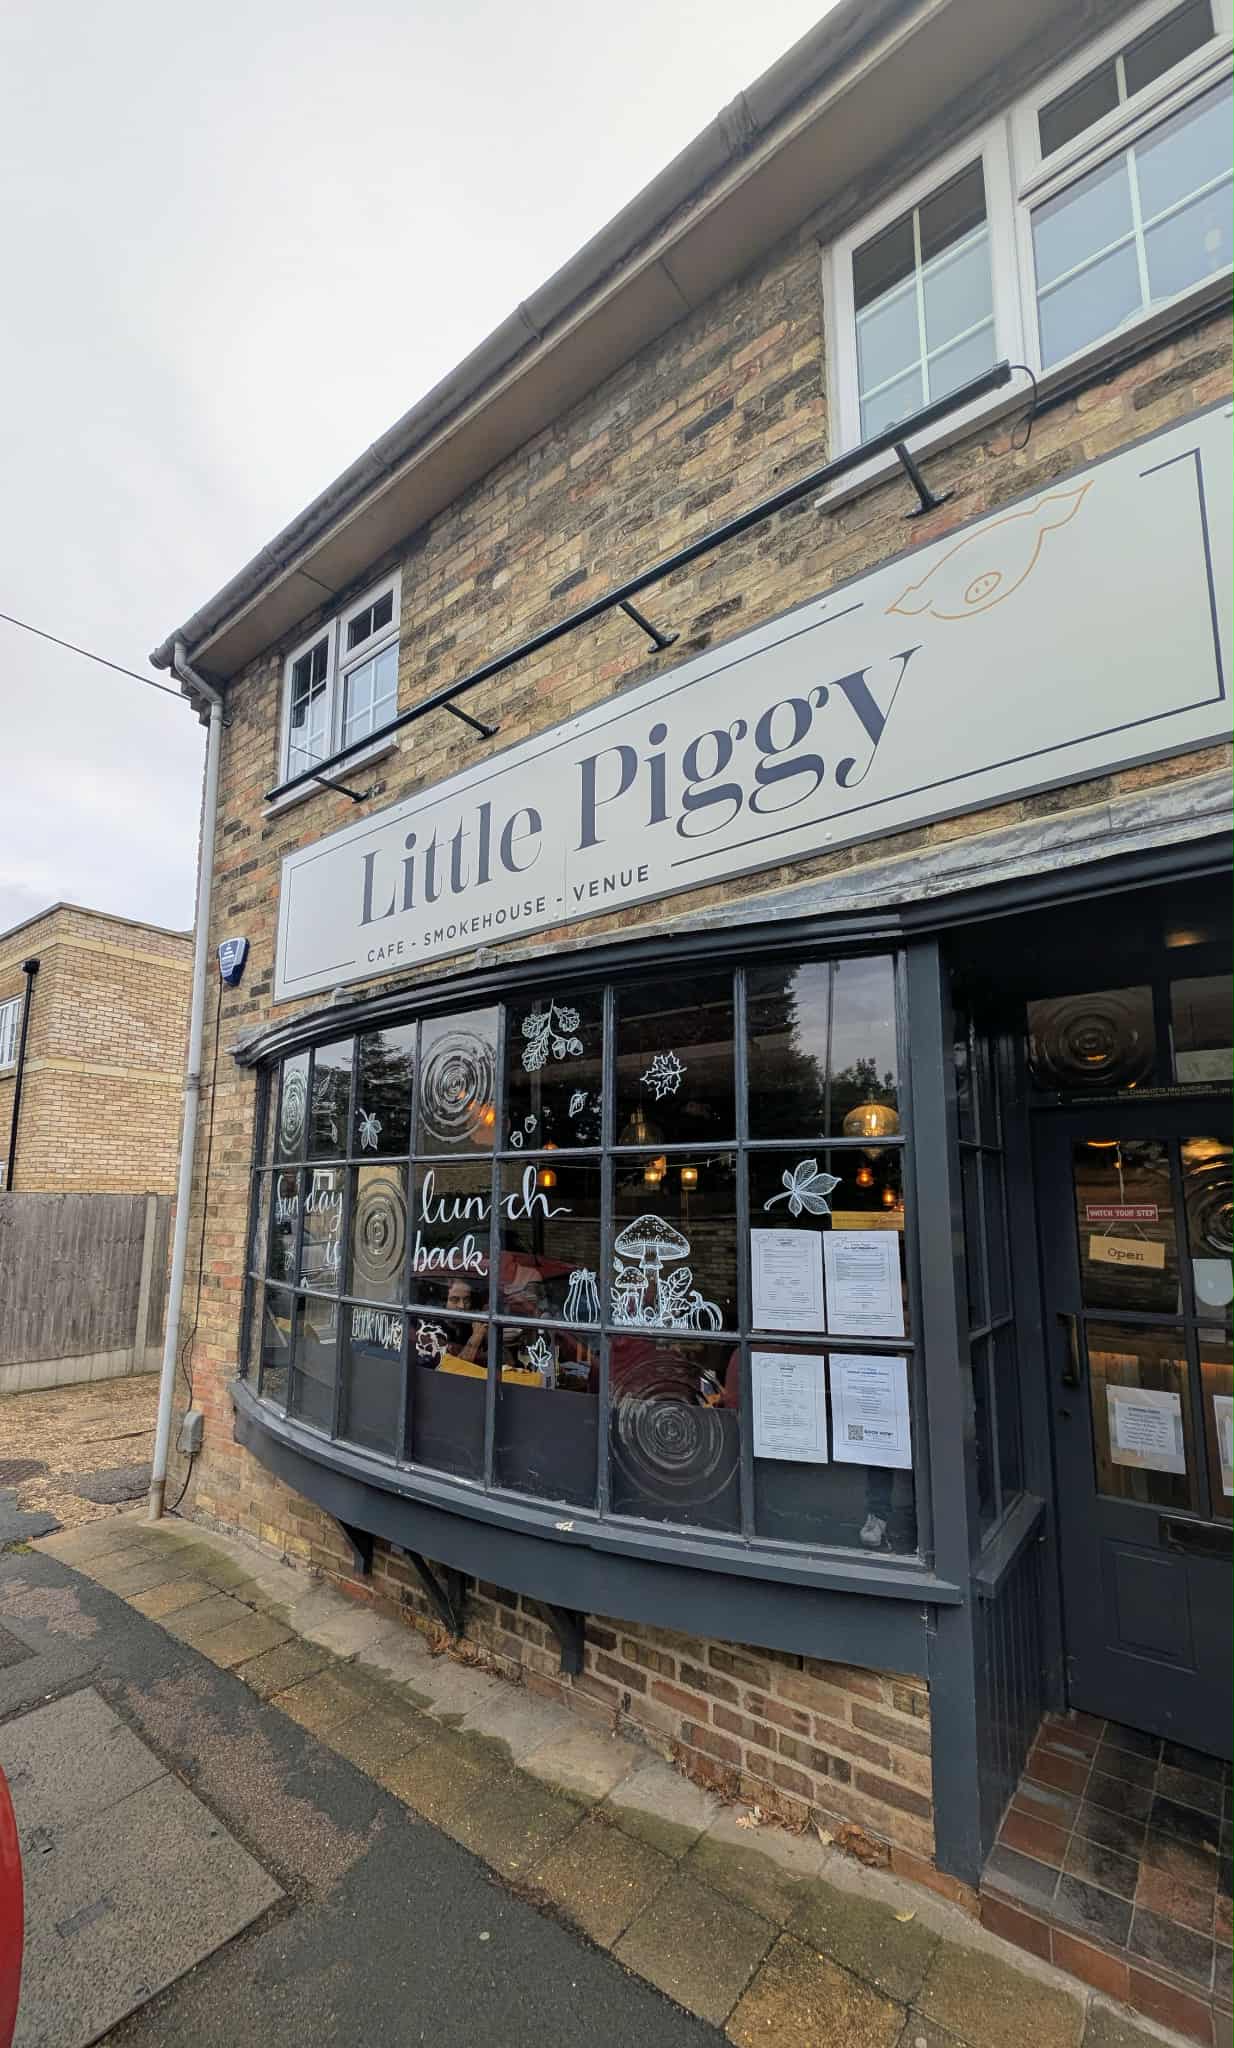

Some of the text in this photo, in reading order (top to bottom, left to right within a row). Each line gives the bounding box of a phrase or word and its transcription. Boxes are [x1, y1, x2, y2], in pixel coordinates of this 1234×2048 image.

[356, 645, 923, 927] Little Piggy
[367, 940, 405, 963] CAFE
[423, 896, 547, 947] SMOKEHOUSE
[573, 864, 650, 902] VENUE
[418, 1165, 573, 1225] lunch
[1089, 1209, 1155, 1217] WATCH YOUR STEP
[412, 1230, 488, 1277] back
[1107, 1247, 1145, 1261] Open
